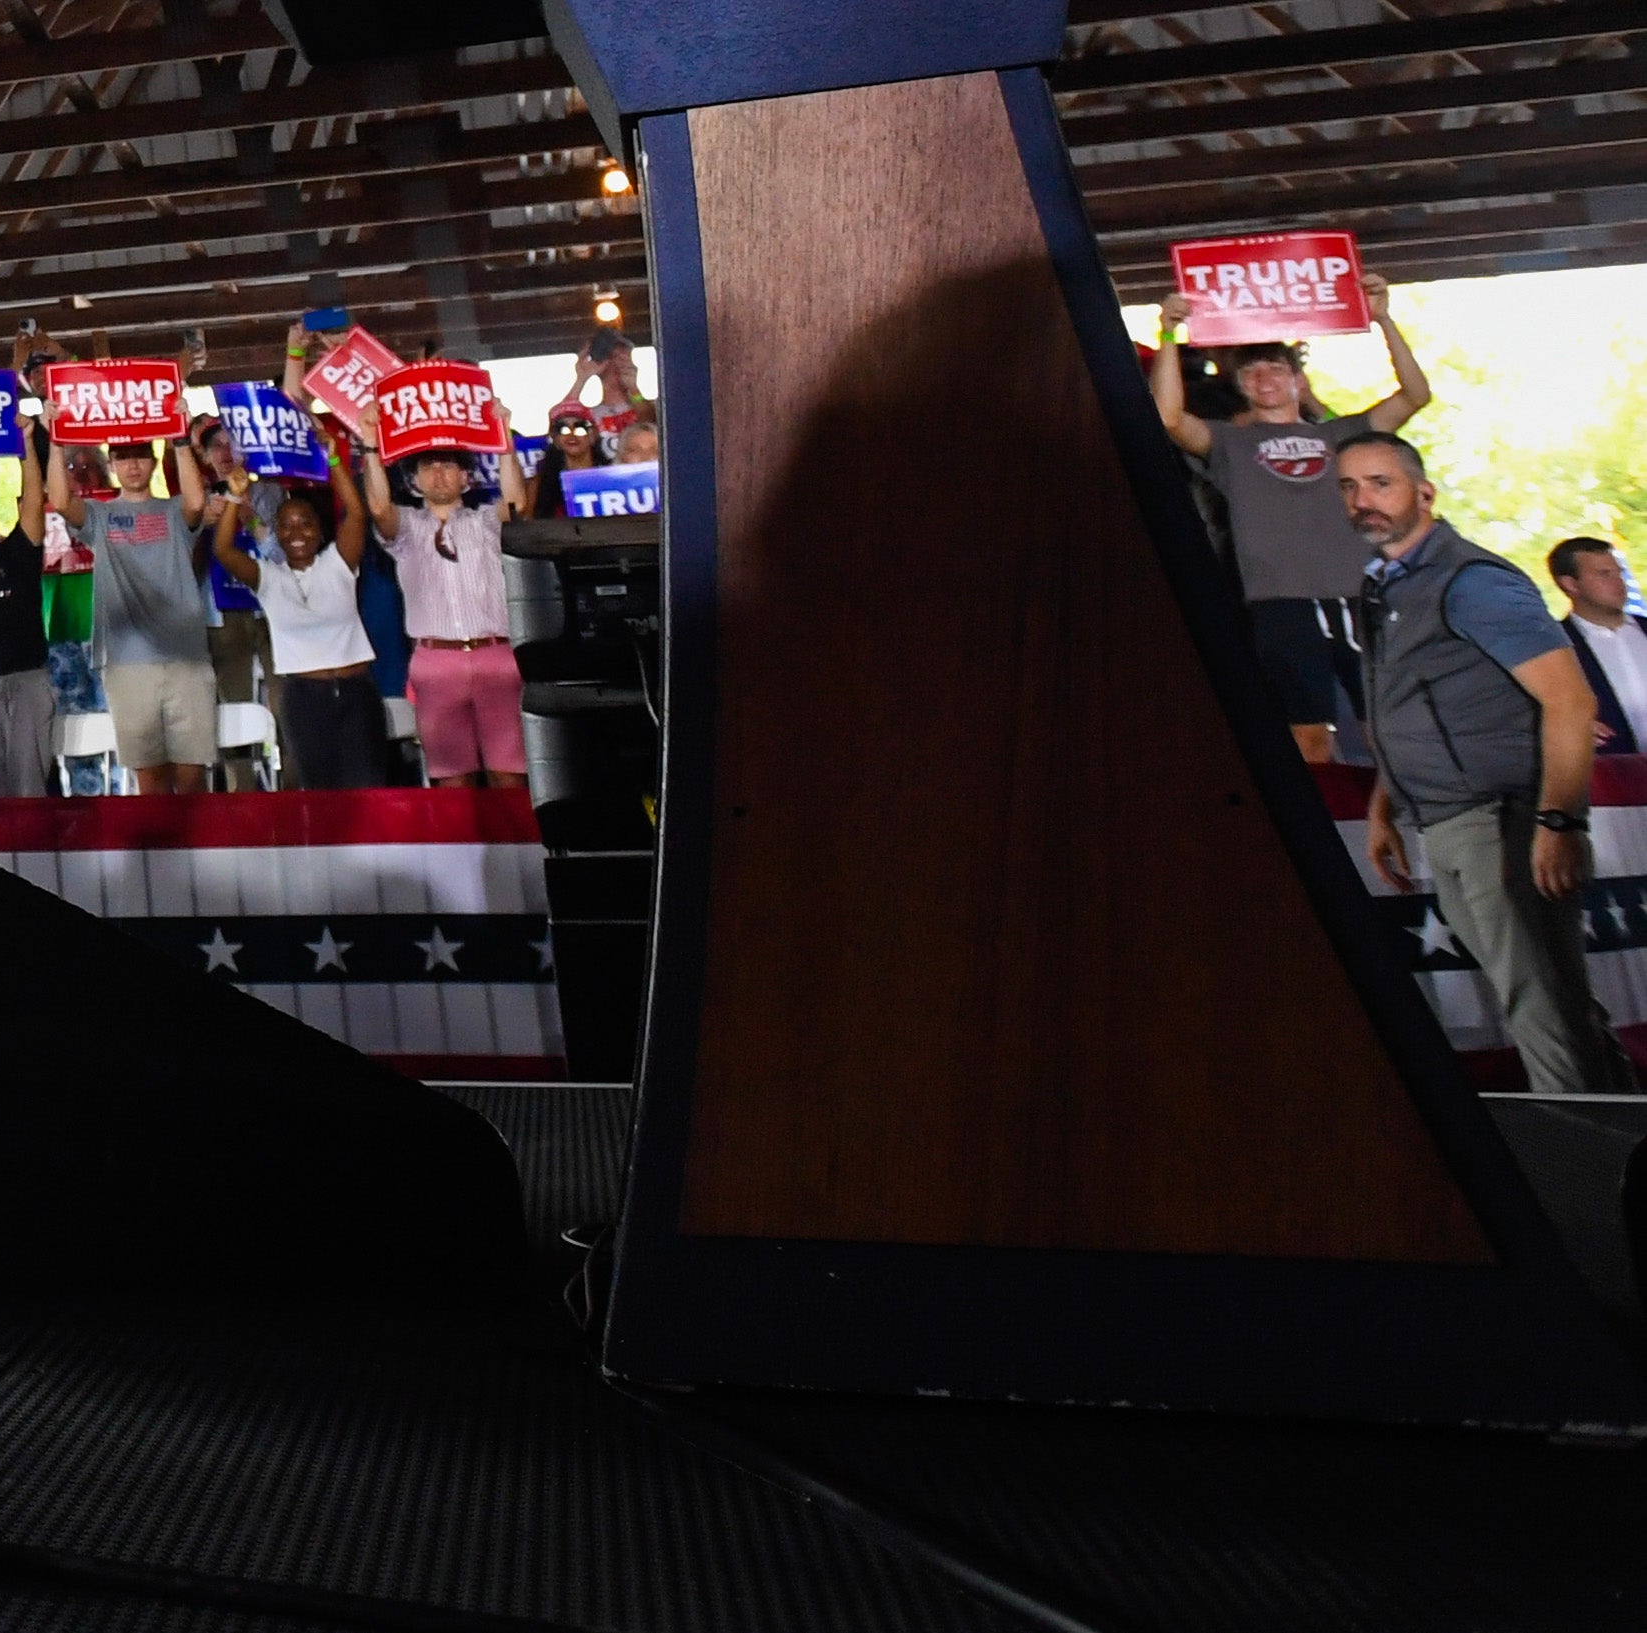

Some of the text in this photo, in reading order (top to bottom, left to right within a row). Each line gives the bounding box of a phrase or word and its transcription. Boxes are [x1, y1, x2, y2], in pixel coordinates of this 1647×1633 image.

[1186, 256, 1350, 291] TRUMP
[1208, 282, 1339, 309] VANCE
[54, 379, 175, 405] TRUMP
[379, 380, 492, 415] TRUMP
[70, 400, 164, 421] VANCE
[220, 405, 312, 431] TRUMP
[393, 402, 483, 427] VANCE
[573, 486, 655, 518] TRU
